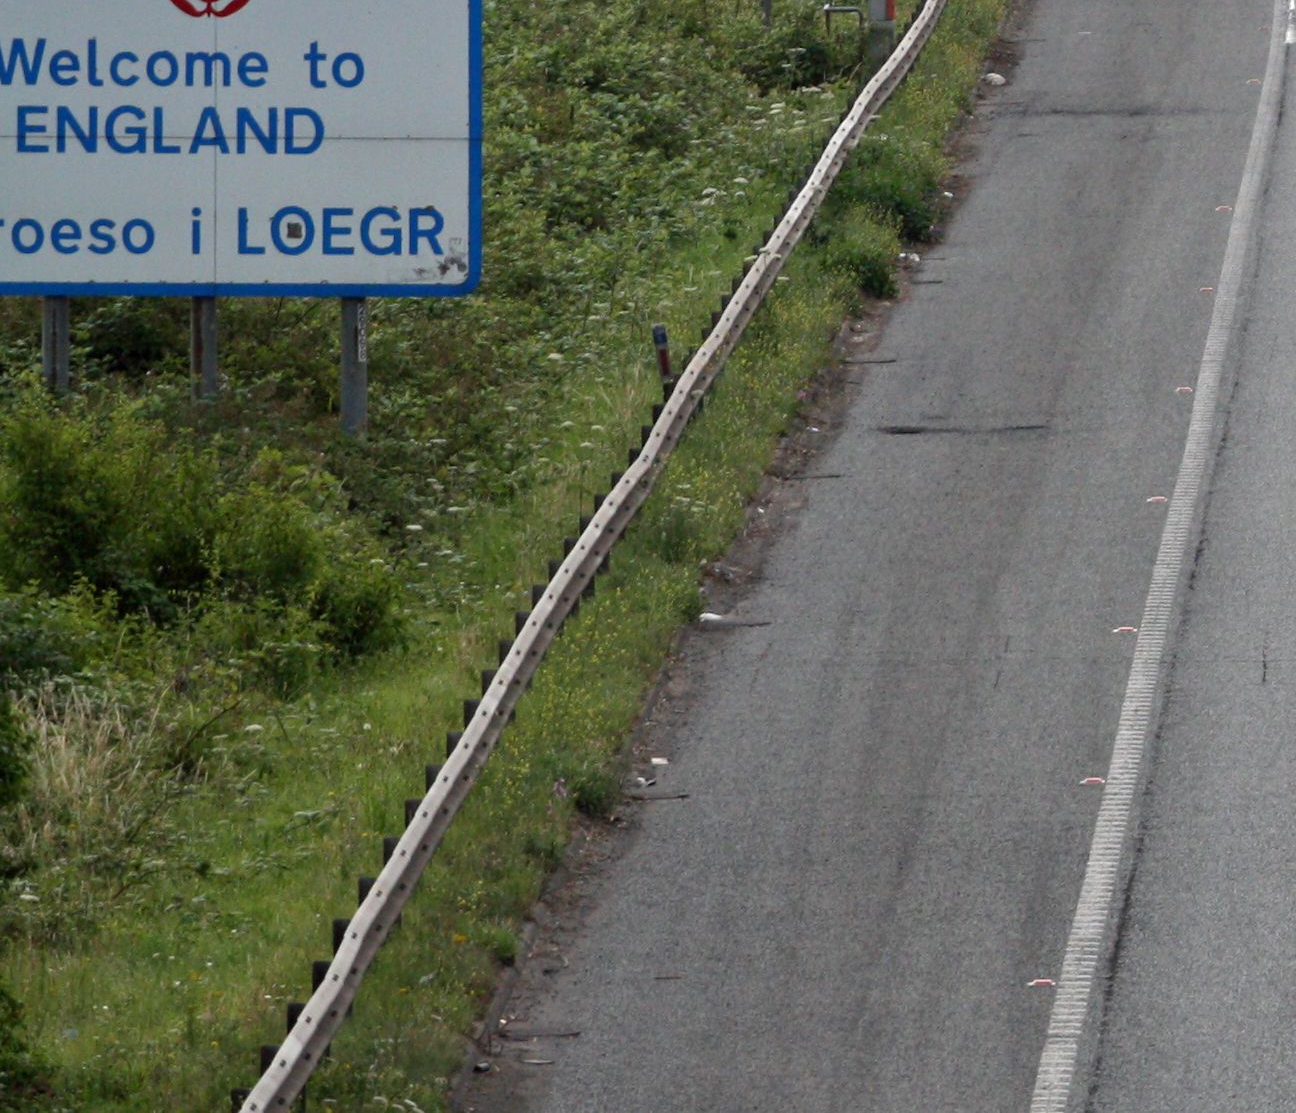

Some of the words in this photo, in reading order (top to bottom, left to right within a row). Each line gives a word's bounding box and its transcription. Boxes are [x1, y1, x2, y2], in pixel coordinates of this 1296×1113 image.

[0, 38, 269, 87] Welcome
[304, 41, 365, 88] to
[16, 105, 326, 155] ENGLAND
[0, 217, 156, 255] oeso
[191, 206, 201, 255] i
[237, 205, 445, 256] LOEGR
